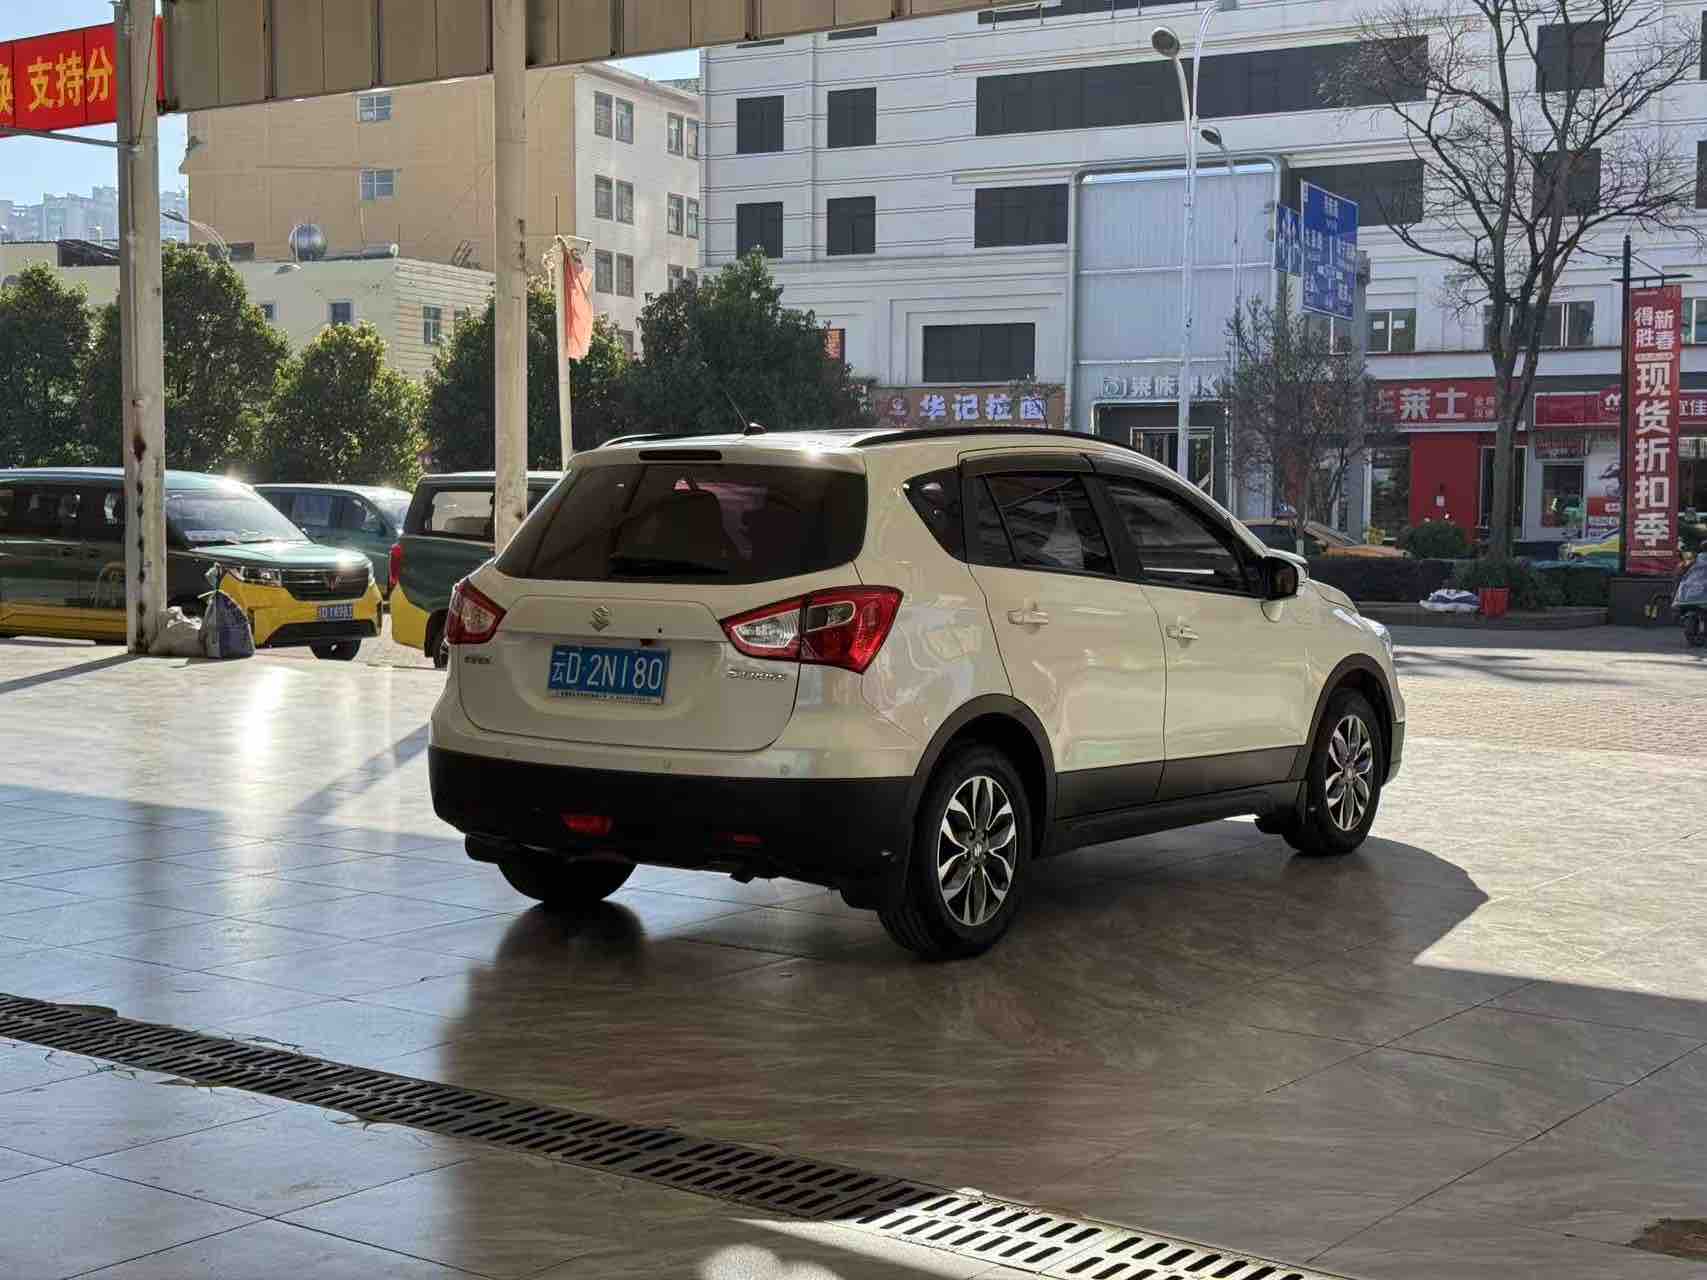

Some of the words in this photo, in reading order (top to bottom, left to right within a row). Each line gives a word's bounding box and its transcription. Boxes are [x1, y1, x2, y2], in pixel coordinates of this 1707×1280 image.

[1655, 309, 1675, 350] 新春
[1634, 361, 1671, 547] 现货折扣季
